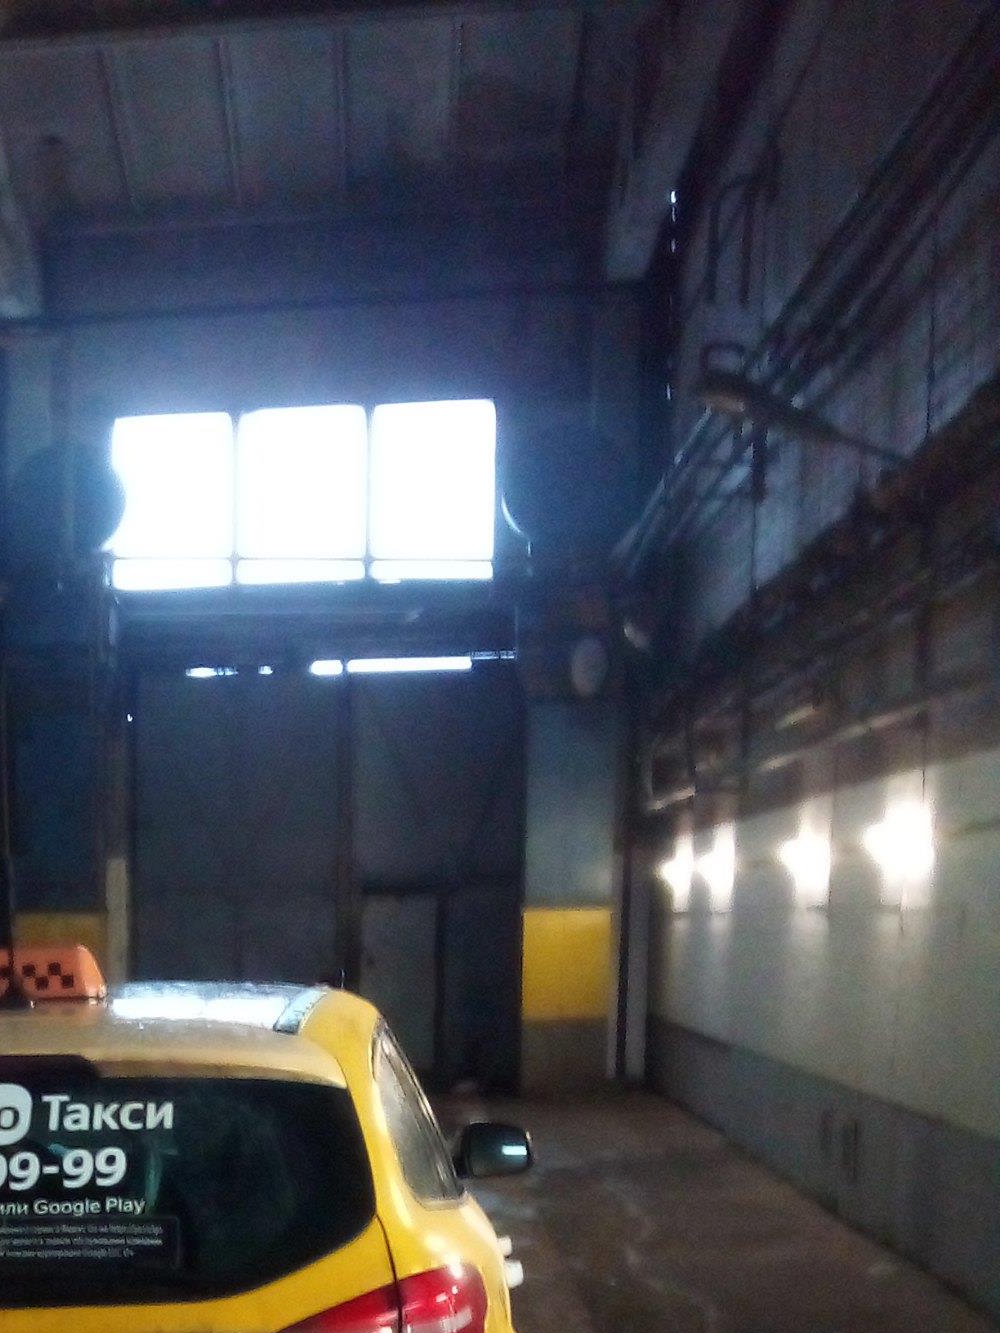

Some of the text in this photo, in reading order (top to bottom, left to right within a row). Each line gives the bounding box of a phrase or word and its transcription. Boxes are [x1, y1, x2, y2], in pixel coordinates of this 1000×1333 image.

[41, 1094, 175, 1133] Такси
[33, 1199, 101, 1218] Google
[105, 1197, 146, 1215] Play
